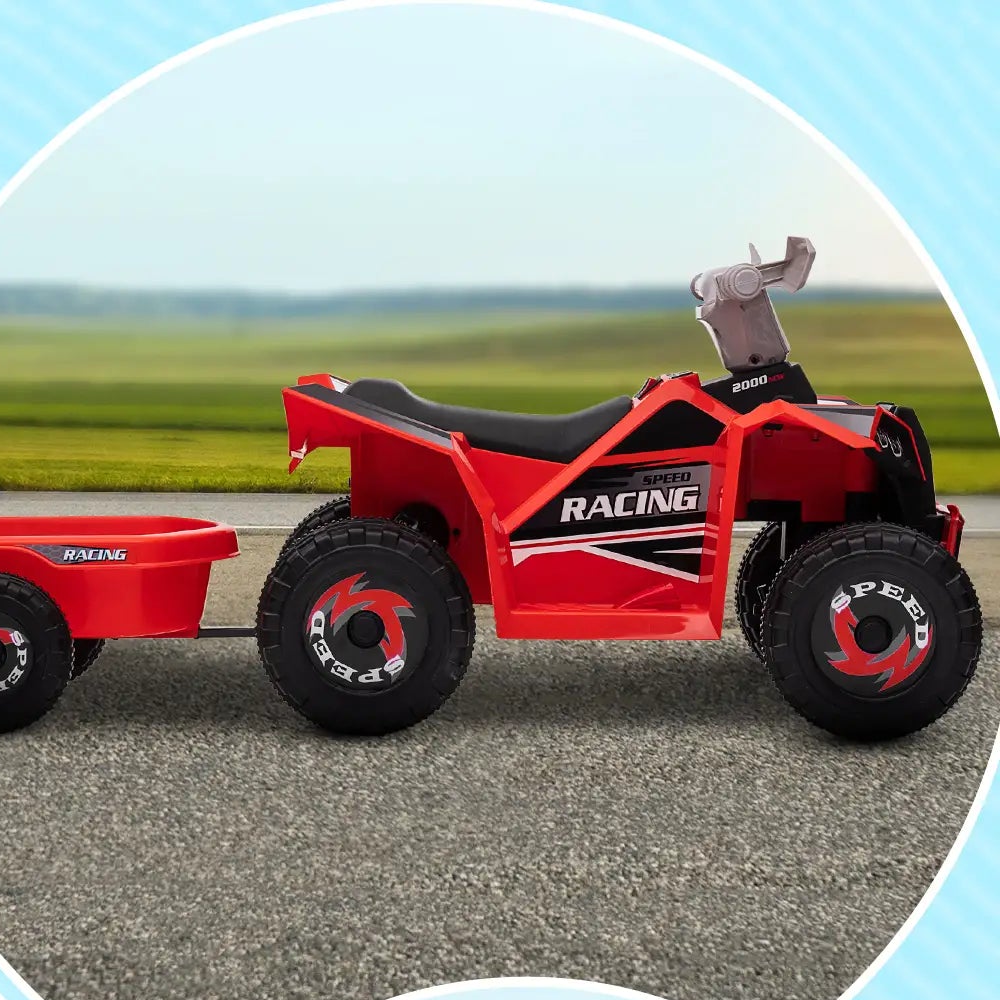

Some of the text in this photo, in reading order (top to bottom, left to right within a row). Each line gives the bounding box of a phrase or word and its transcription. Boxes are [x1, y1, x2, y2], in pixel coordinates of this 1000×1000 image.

[732, 374, 768, 393] 2000
[643, 472, 691, 486] SPEED
[560, 486, 700, 523] RACING
[63, 549, 127, 561] RACING
[830, 581, 930, 649] SPEED
[310, 611, 405, 684] SPEED
